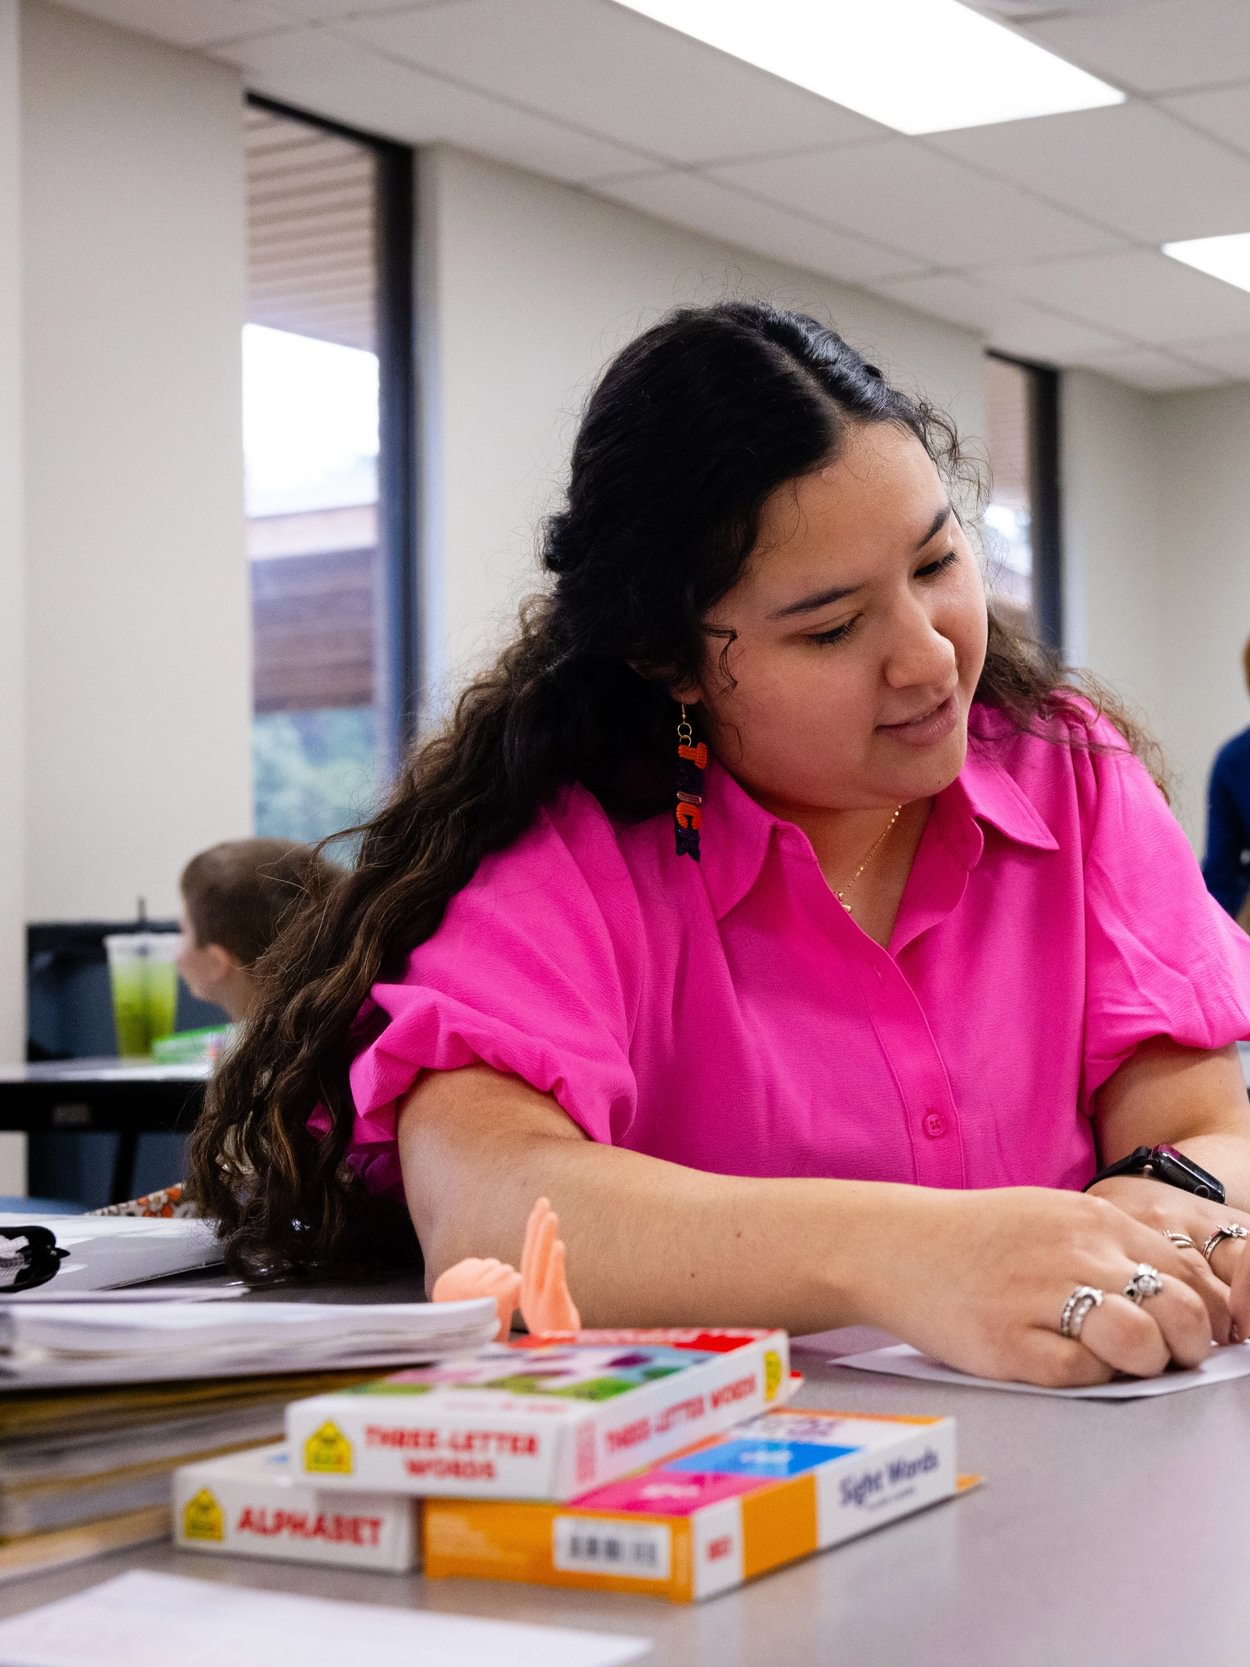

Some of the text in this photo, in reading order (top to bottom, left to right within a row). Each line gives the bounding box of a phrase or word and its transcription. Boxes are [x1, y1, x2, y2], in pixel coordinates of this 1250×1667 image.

[606, 1375, 756, 1451] THREE-LETTER WORDS
[364, 1425, 539, 1455] THREE-LETTER
[405, 1458, 497, 1480] WORDS
[840, 1471, 883, 1507] Sight
[887, 1446, 938, 1484] Words
[237, 1506, 382, 1546] ALPHABET
